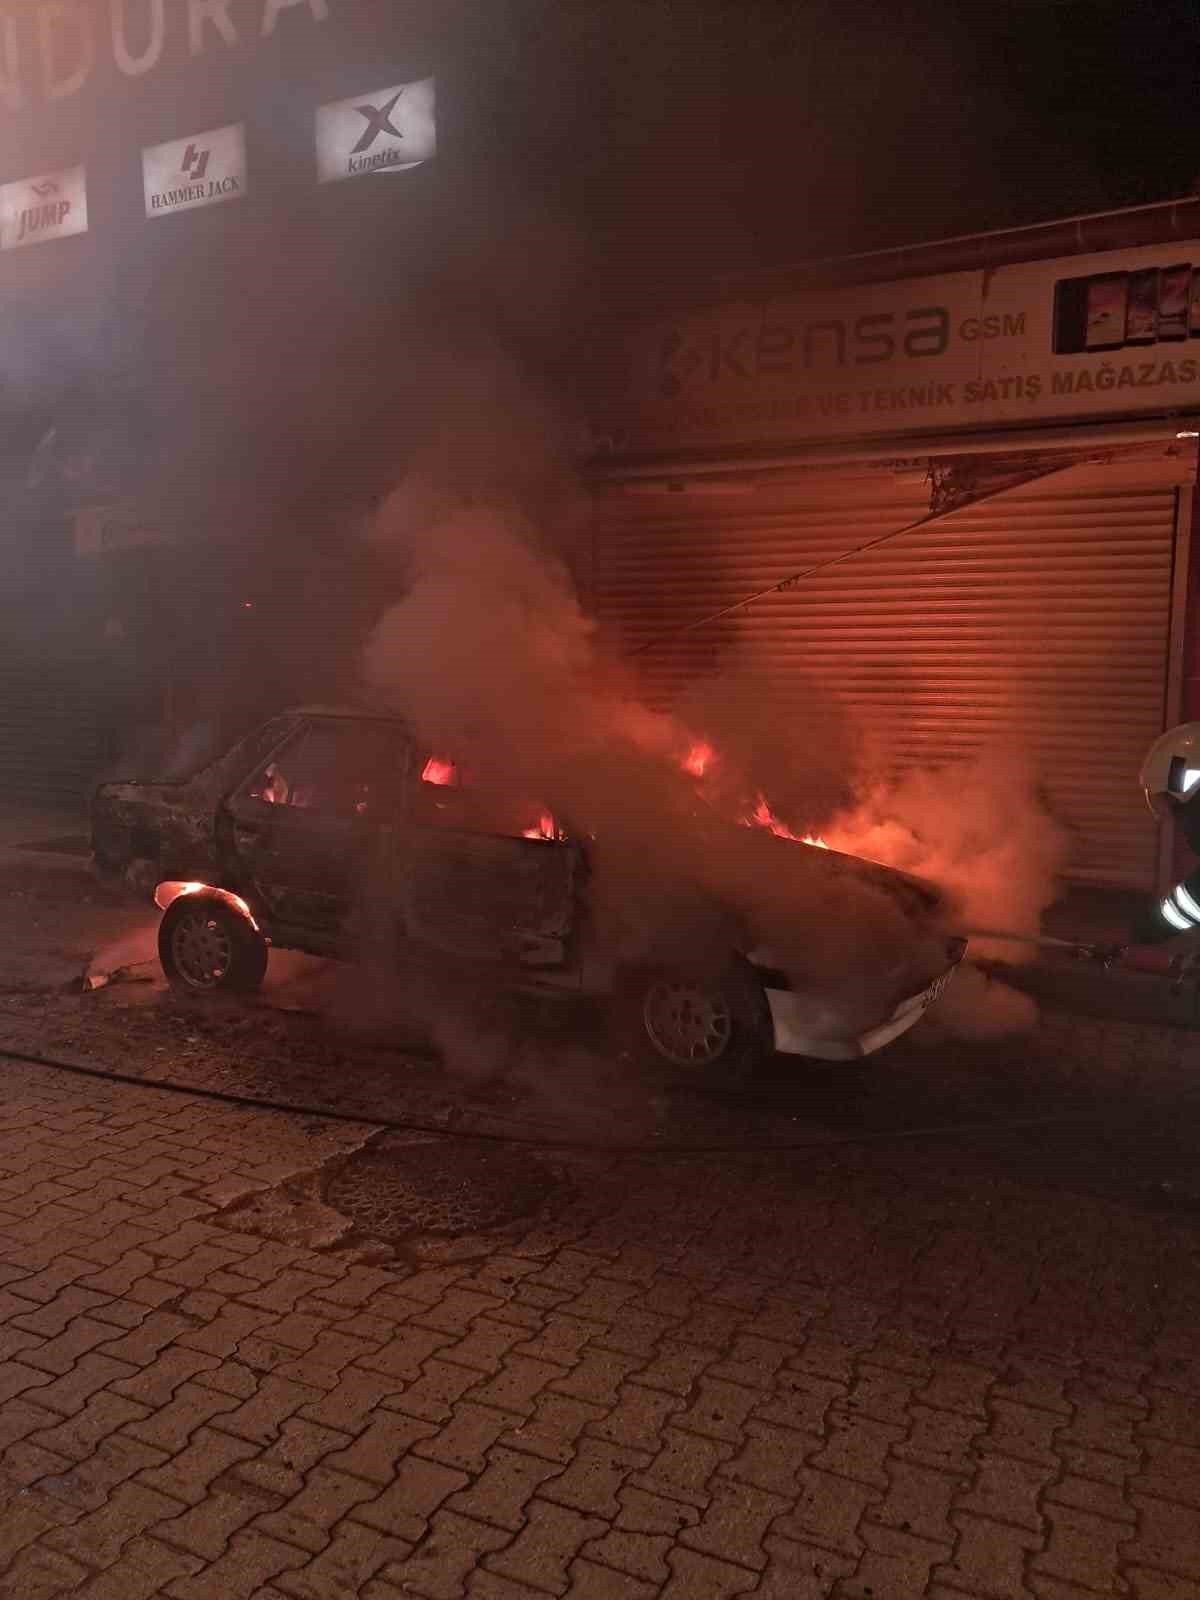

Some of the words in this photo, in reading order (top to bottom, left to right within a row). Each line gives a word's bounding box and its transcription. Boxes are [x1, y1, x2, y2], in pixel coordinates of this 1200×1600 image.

[151, 184, 205, 209] HAMMER
[207, 176, 240, 198] JACK
[17, 199, 71, 240] JUMP
[960, 312, 1027, 341] GSM
[856, 379, 956, 412] TEKNİK
[963, 375, 1042, 403] SATIŞ
